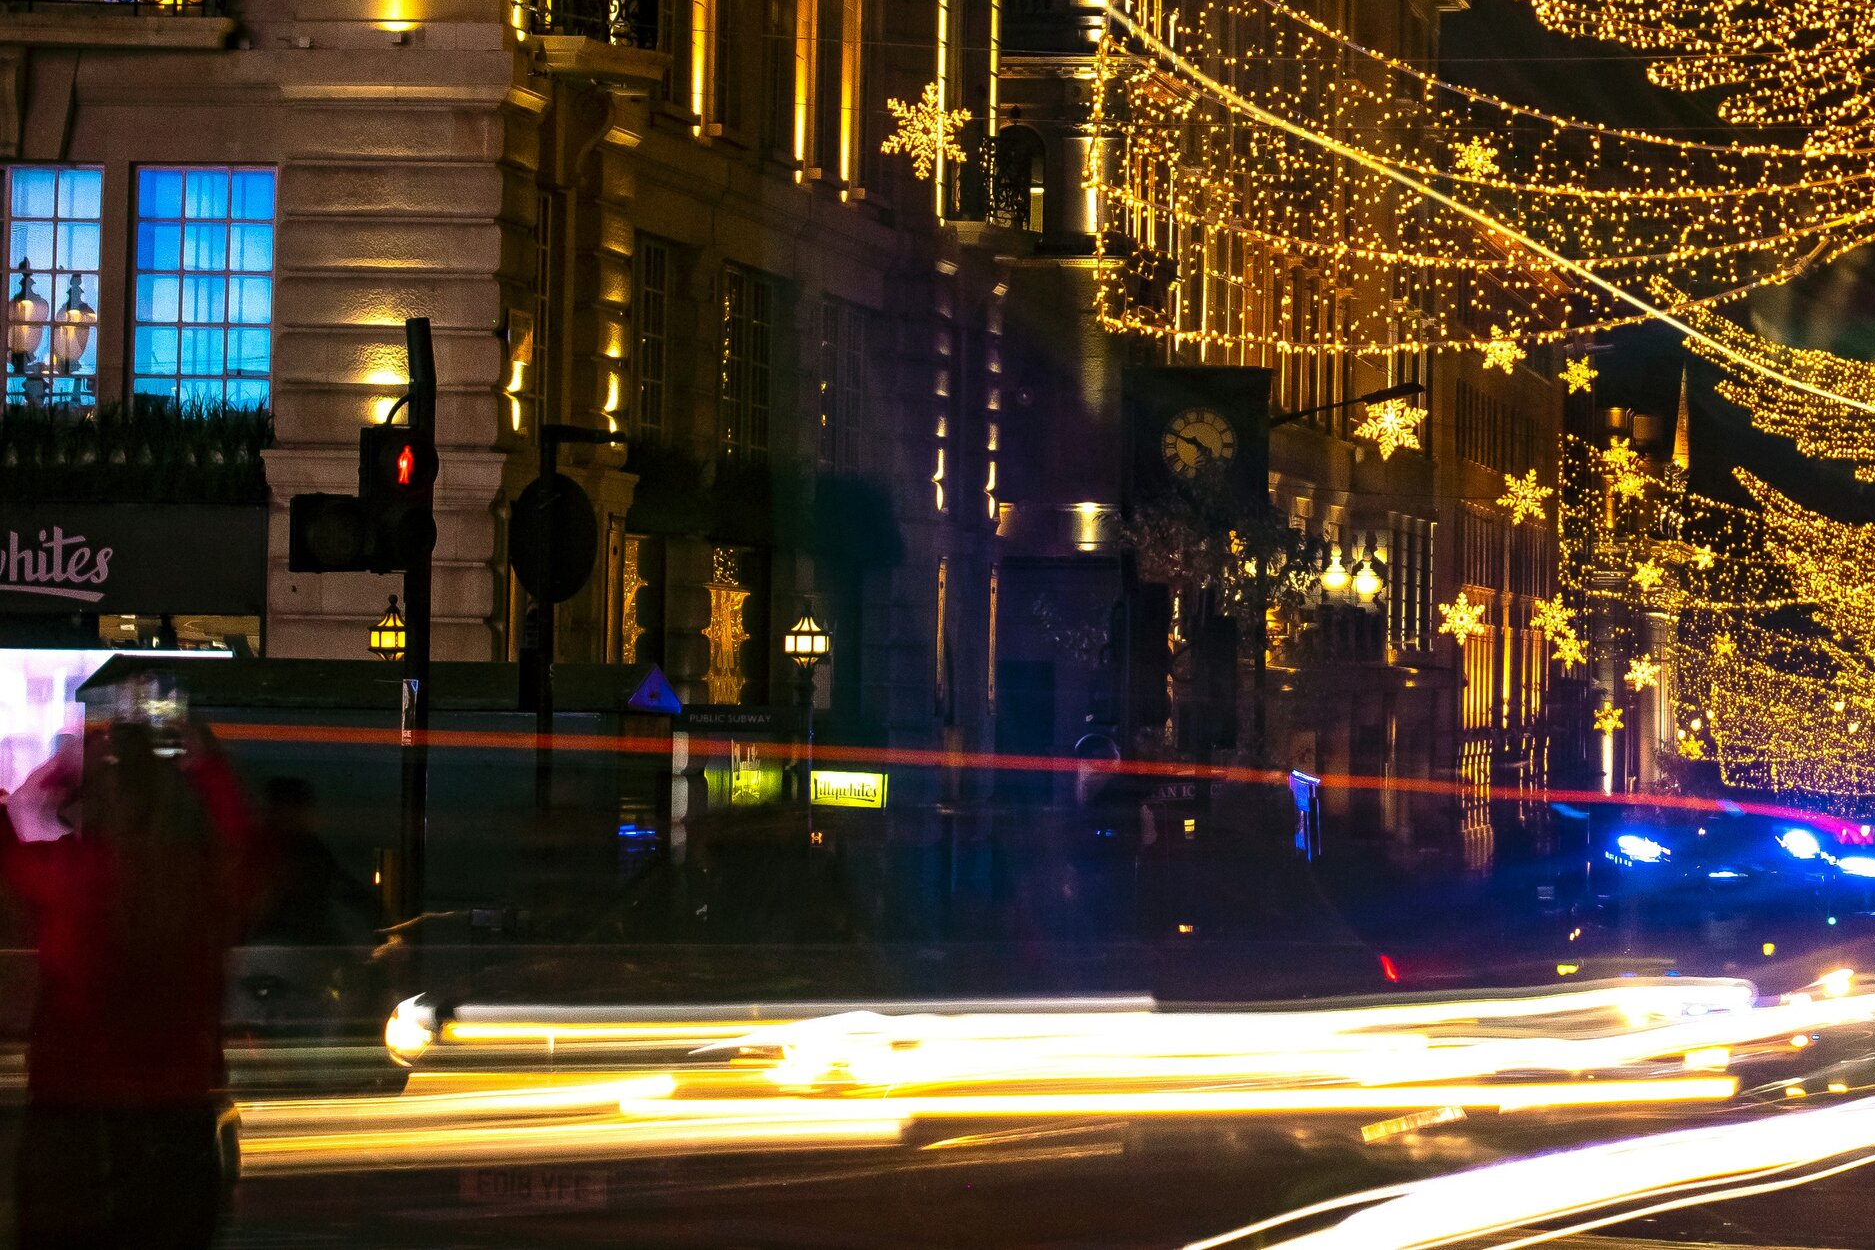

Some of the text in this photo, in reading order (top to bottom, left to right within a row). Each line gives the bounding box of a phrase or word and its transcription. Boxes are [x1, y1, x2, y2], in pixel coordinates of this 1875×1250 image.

[0, 525, 113, 583] hites
[689, 714, 772, 723] PUBLIC SUBWAY
